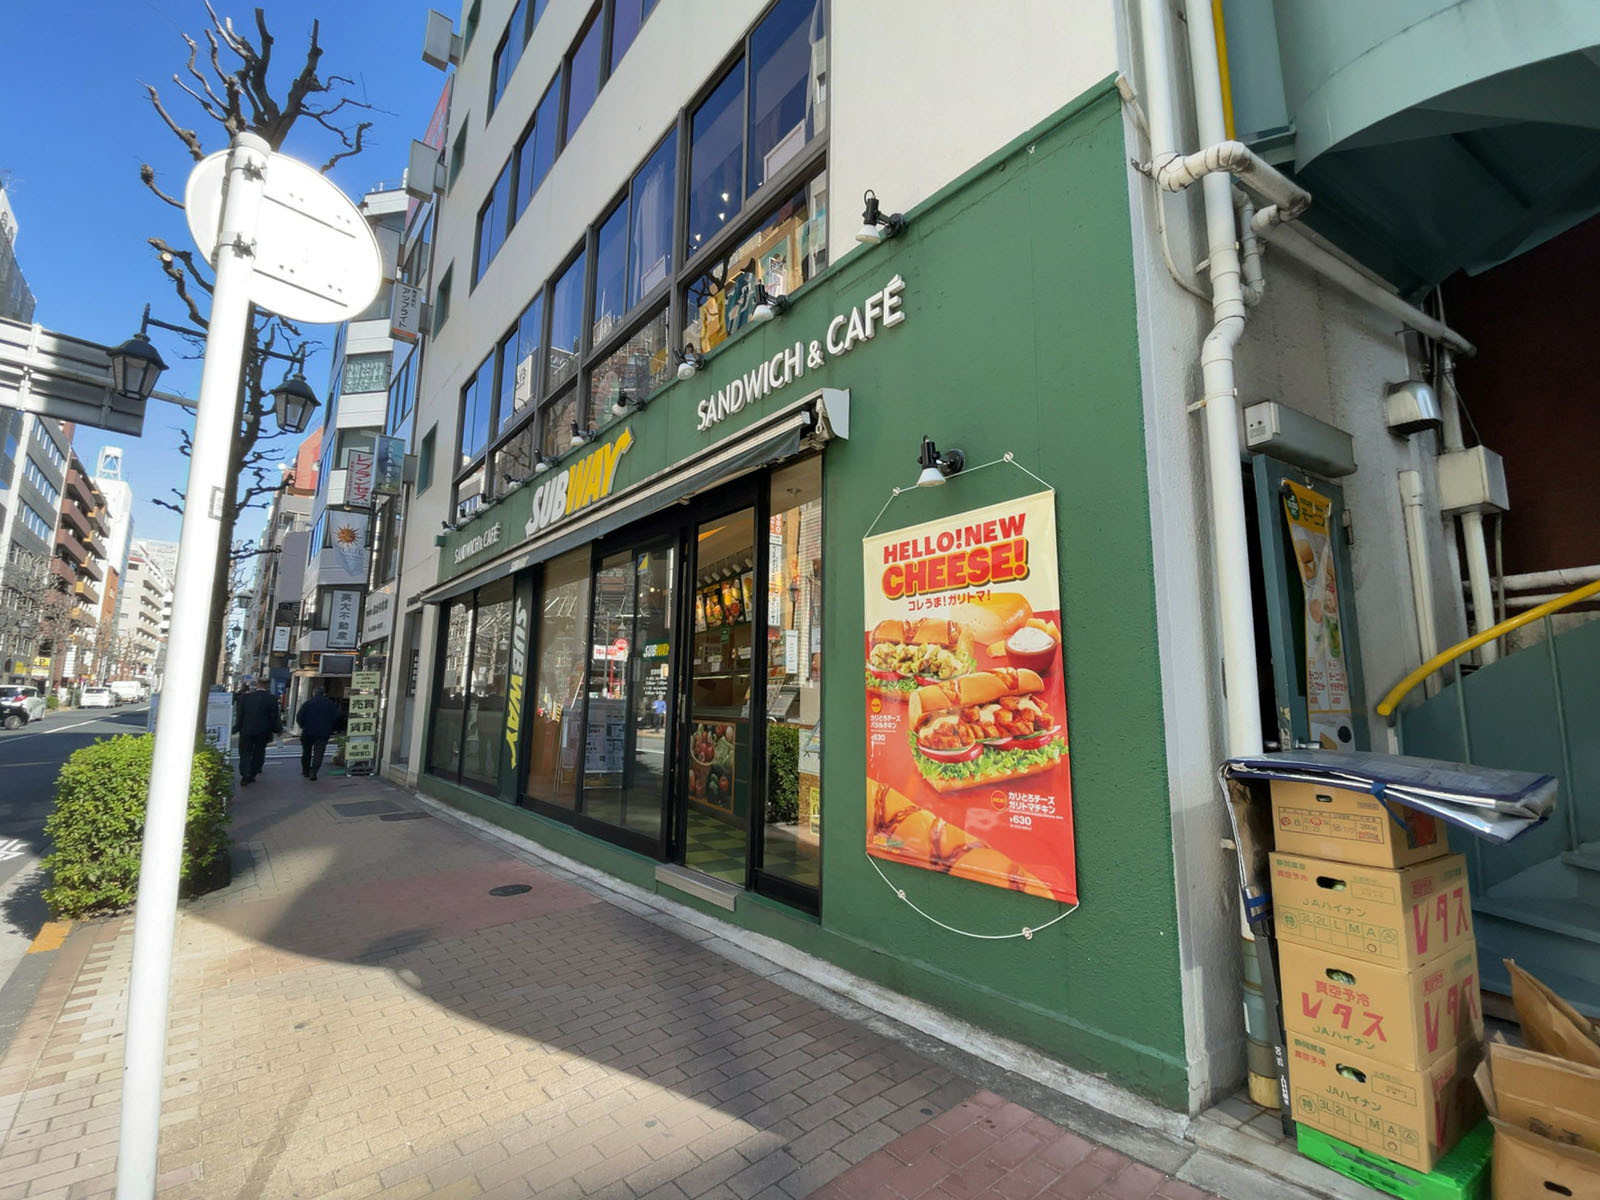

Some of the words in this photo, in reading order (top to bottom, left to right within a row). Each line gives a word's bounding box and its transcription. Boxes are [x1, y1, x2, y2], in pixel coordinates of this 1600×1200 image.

[697, 342, 804, 432] SANDWICH
[806, 339, 824, 370] &
[826, 274, 906, 357] CAFÉ
[525, 425, 635, 538] SUBWAY
[881, 536, 1030, 600] CHEESE!
[507, 597, 529, 770] SUBWAY
[1348, 923, 1361, 935] M
[1412, 887, 1469, 956] レタス
[1366, 927, 1377, 938] A
[1315, 980, 1371, 1008] 真空予冷
[1301, 991, 1388, 1043] レタス
[1320, 1099, 1331, 1112] 3L
[1335, 1105, 1346, 1118] 2L
[1354, 1112, 1361, 1123] L
[1369, 1118, 1380, 1129] M
[1387, 1125, 1397, 1136] A
